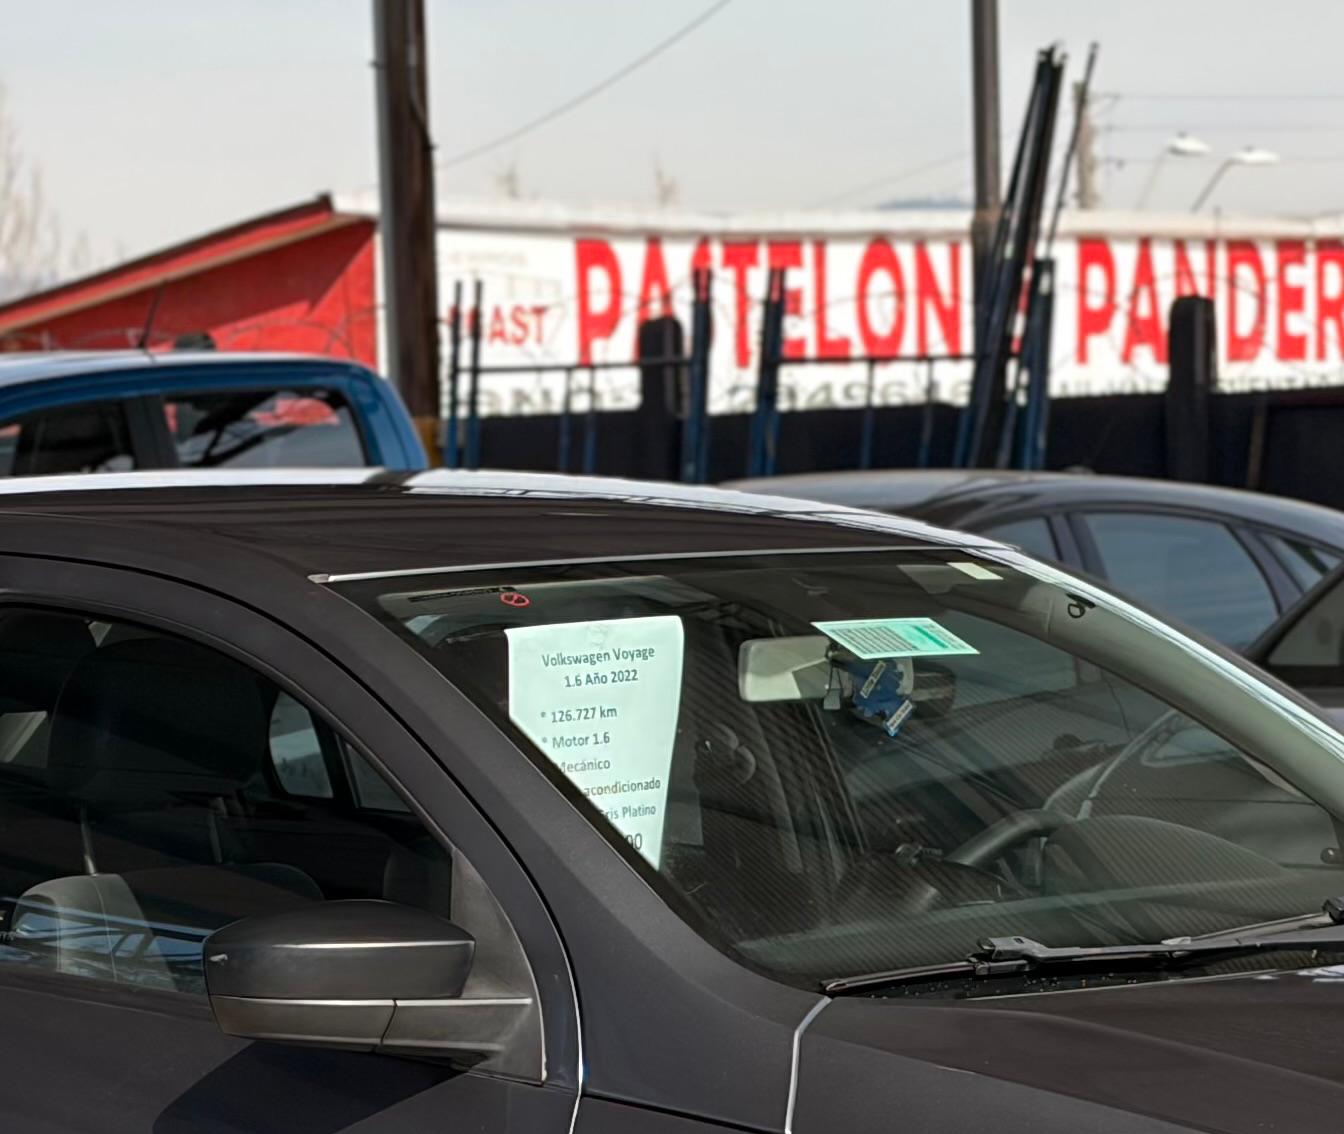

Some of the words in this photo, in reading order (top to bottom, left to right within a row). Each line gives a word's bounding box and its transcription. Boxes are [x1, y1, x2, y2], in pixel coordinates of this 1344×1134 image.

[541, 650, 610, 667] Volkswagen
[613, 646, 655, 662] Voyage
[565, 674, 582, 688] 1.6
[585, 672, 607, 685] Año
[611, 669, 638, 683] 2022
[551, 707, 596, 723] 126.727
[600, 705, 617, 718] km
[552, 735, 590, 749] Motor
[593, 731, 610, 745] 1.6
[622, 804, 656, 818] Platino
